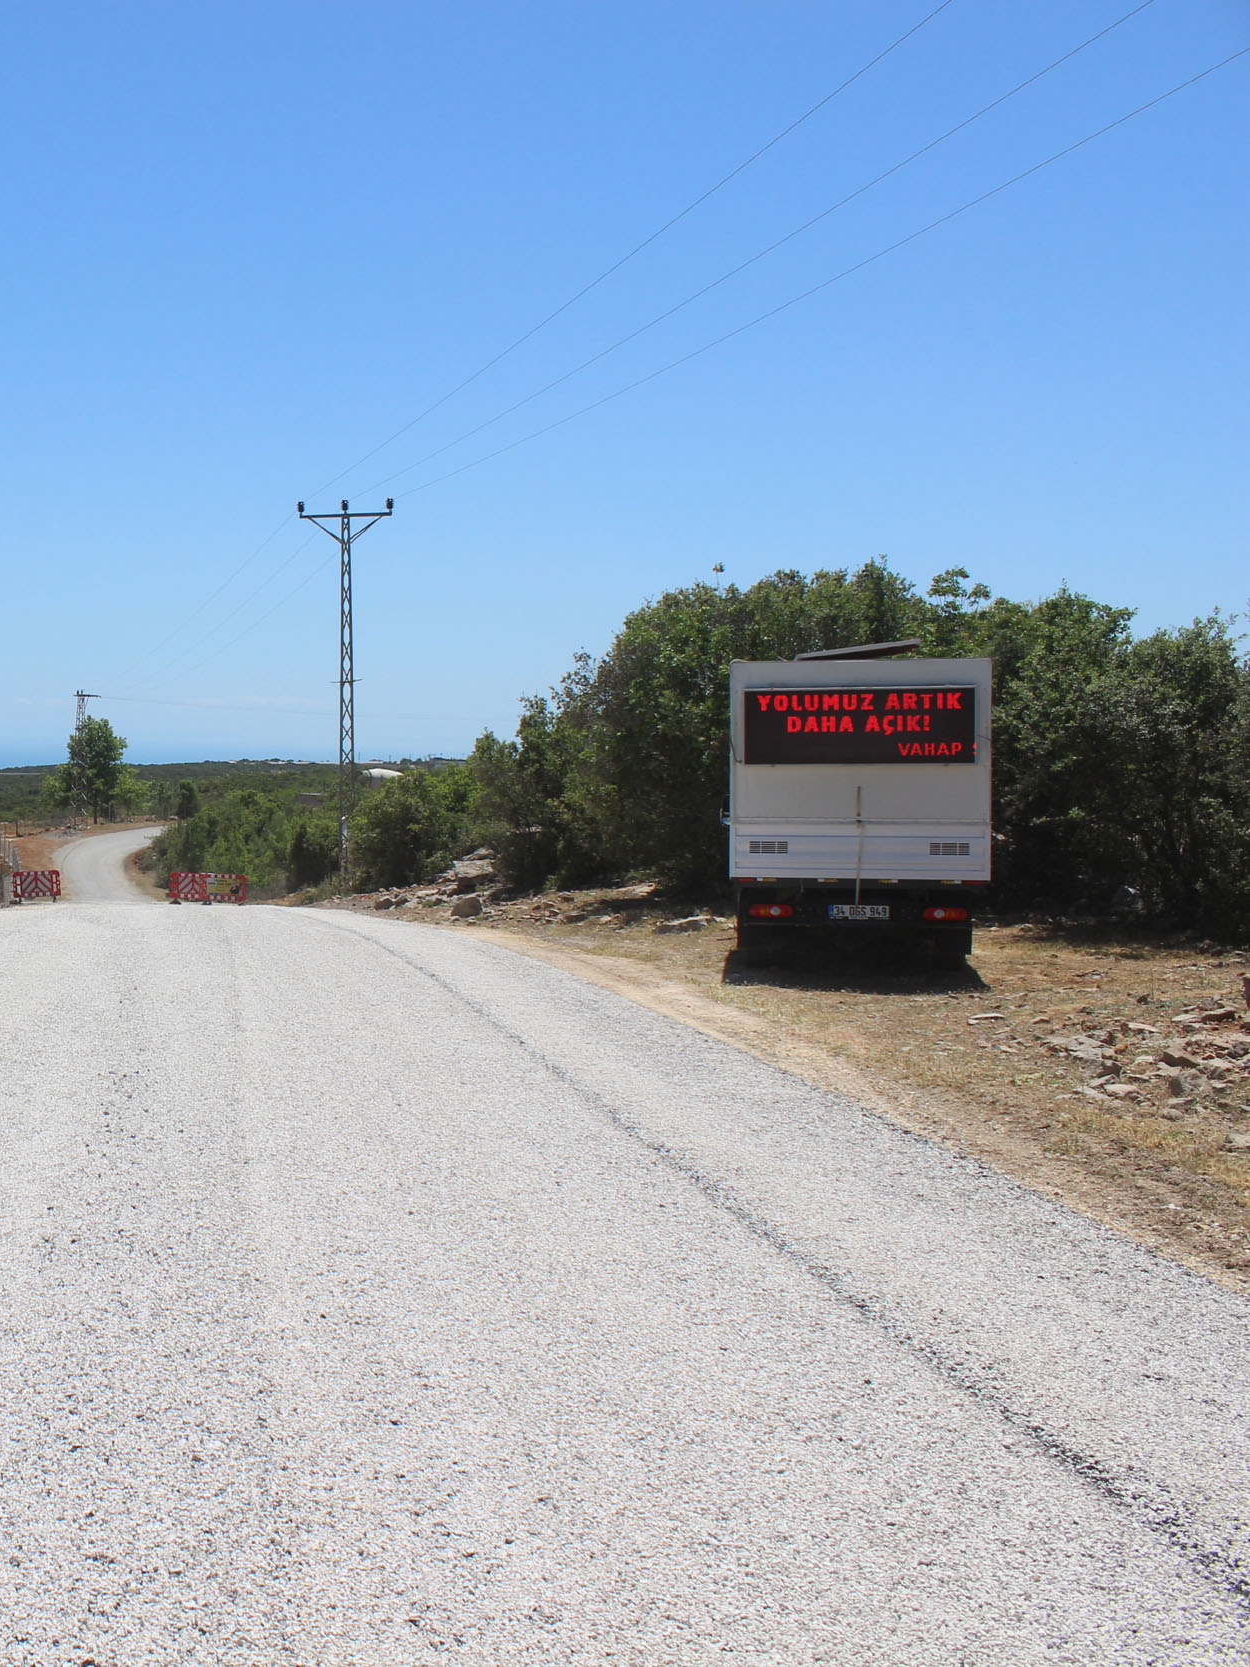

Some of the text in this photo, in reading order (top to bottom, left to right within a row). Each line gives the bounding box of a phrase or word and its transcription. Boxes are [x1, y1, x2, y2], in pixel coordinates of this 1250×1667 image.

[757, 692, 963, 711] YOLUMUZ ARTIK
[786, 714, 931, 735] DAHA AÇIK!
[897, 742, 963, 756] VAHAP
[834, 906, 846, 916] 34
[870, 906, 887, 917] 949
